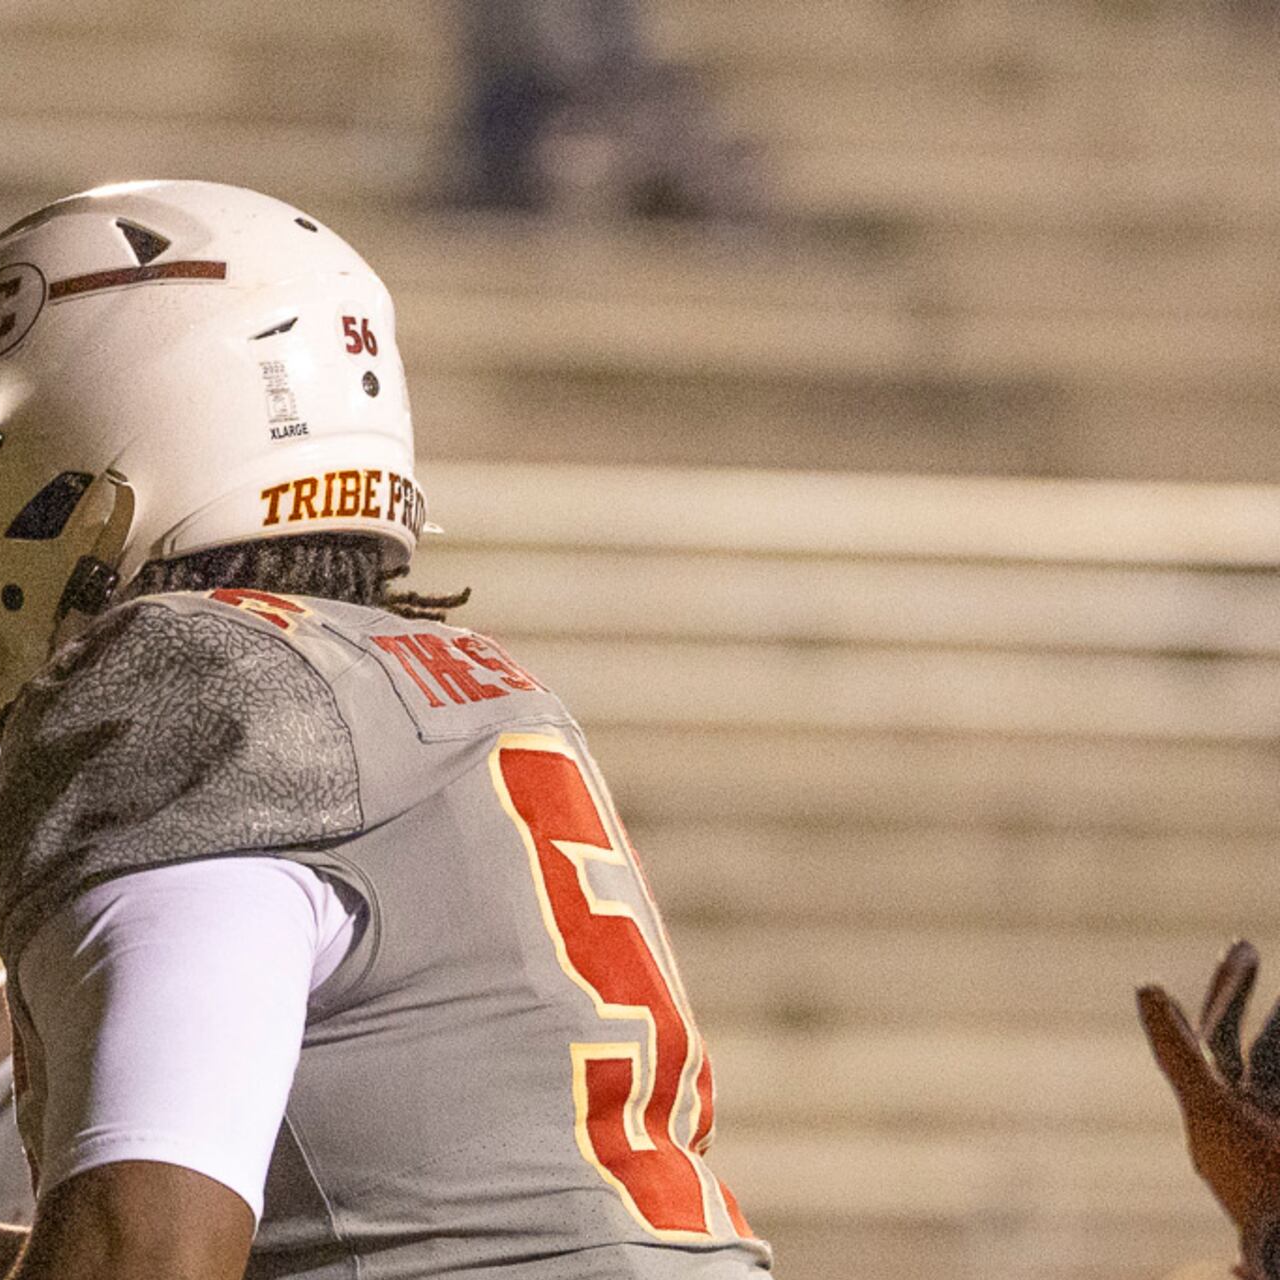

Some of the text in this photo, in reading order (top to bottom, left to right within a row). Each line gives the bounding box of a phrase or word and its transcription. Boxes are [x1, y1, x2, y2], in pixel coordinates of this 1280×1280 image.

[341, 315, 379, 357] 56
[269, 422, 309, 440] XLARGE
[261, 469, 382, 527] TRIBE
[488, 732, 760, 1242] 5
